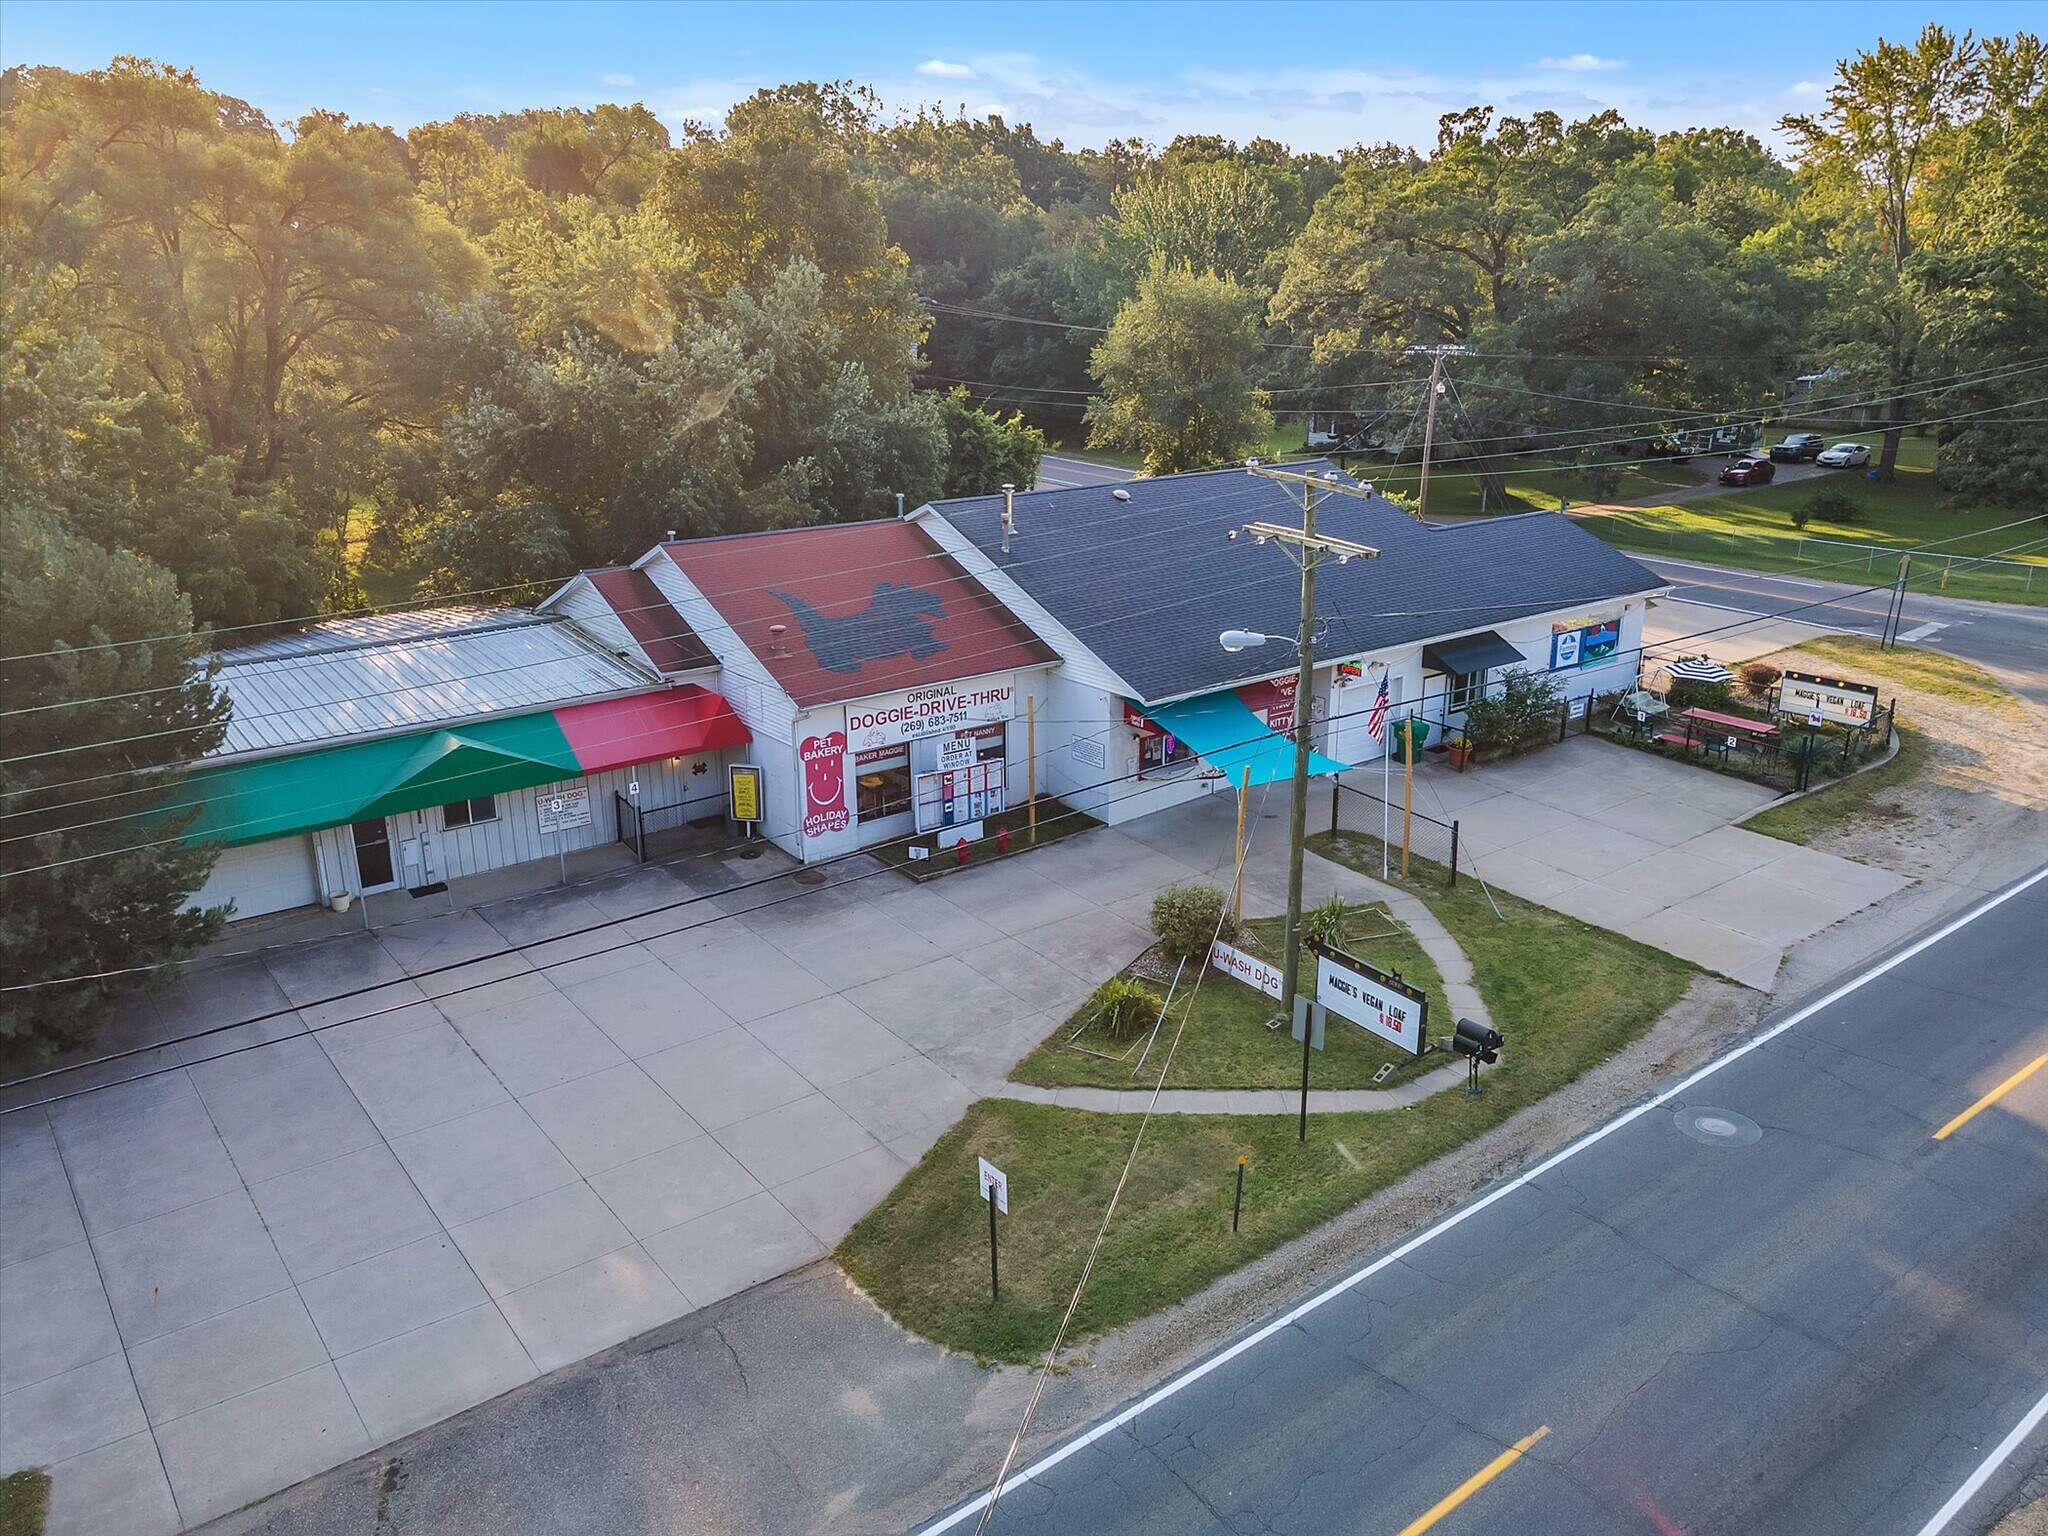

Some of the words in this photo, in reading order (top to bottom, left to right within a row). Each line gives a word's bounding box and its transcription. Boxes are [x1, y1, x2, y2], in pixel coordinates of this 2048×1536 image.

[1341, 665, 1361, 676] OPEN
[907, 686, 957, 703] ORIGINAL
[1826, 694, 1844, 706] VEGAN
[1269, 716, 1294, 728] KITTY
[1639, 712, 1645, 721] 1
[900, 720, 925, 736] (269)
[928, 711, 967, 728] 683-7511
[813, 738, 833, 749] PET
[943, 739, 971, 753] MENU
[1729, 737, 1736, 746] 2
[803, 745, 844, 761] BAKERY
[879, 745, 904, 757] MAGGIE
[941, 754, 964, 763] ORDER
[943, 760, 970, 769] WINDOW
[631, 784, 638, 792] 4
[553, 801, 560, 810] 3
[805, 810, 848, 827] HOLIDAY
[806, 820, 847, 837] SHAPES
[1213, 947, 1252, 976] U-WASH
[1328, 974, 1358, 999] MAGGIE'S
[1362, 991, 1384, 1012] VEGAN
[1388, 1004, 1407, 1022] LOAF
[984, 1170, 1003, 1192] ENTER
